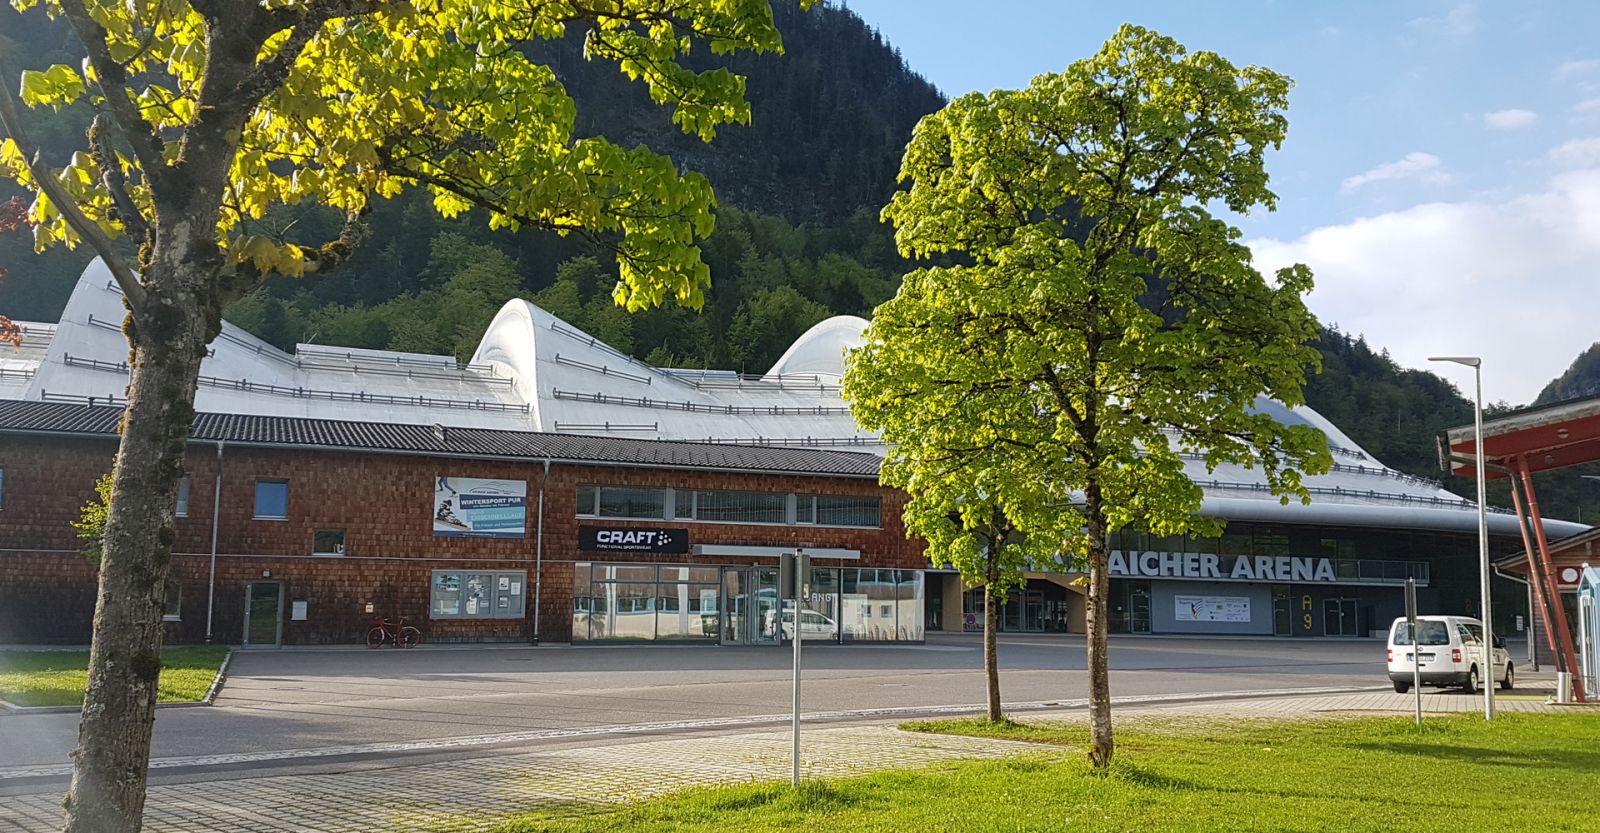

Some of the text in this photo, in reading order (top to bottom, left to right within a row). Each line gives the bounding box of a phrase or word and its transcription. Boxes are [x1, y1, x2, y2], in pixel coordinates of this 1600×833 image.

[597, 530, 656, 544] CRAFT
[1108, 549, 1221, 578] AICHER
[1230, 554, 1336, 582] ARENA
[1303, 613, 1312, 630] 9
